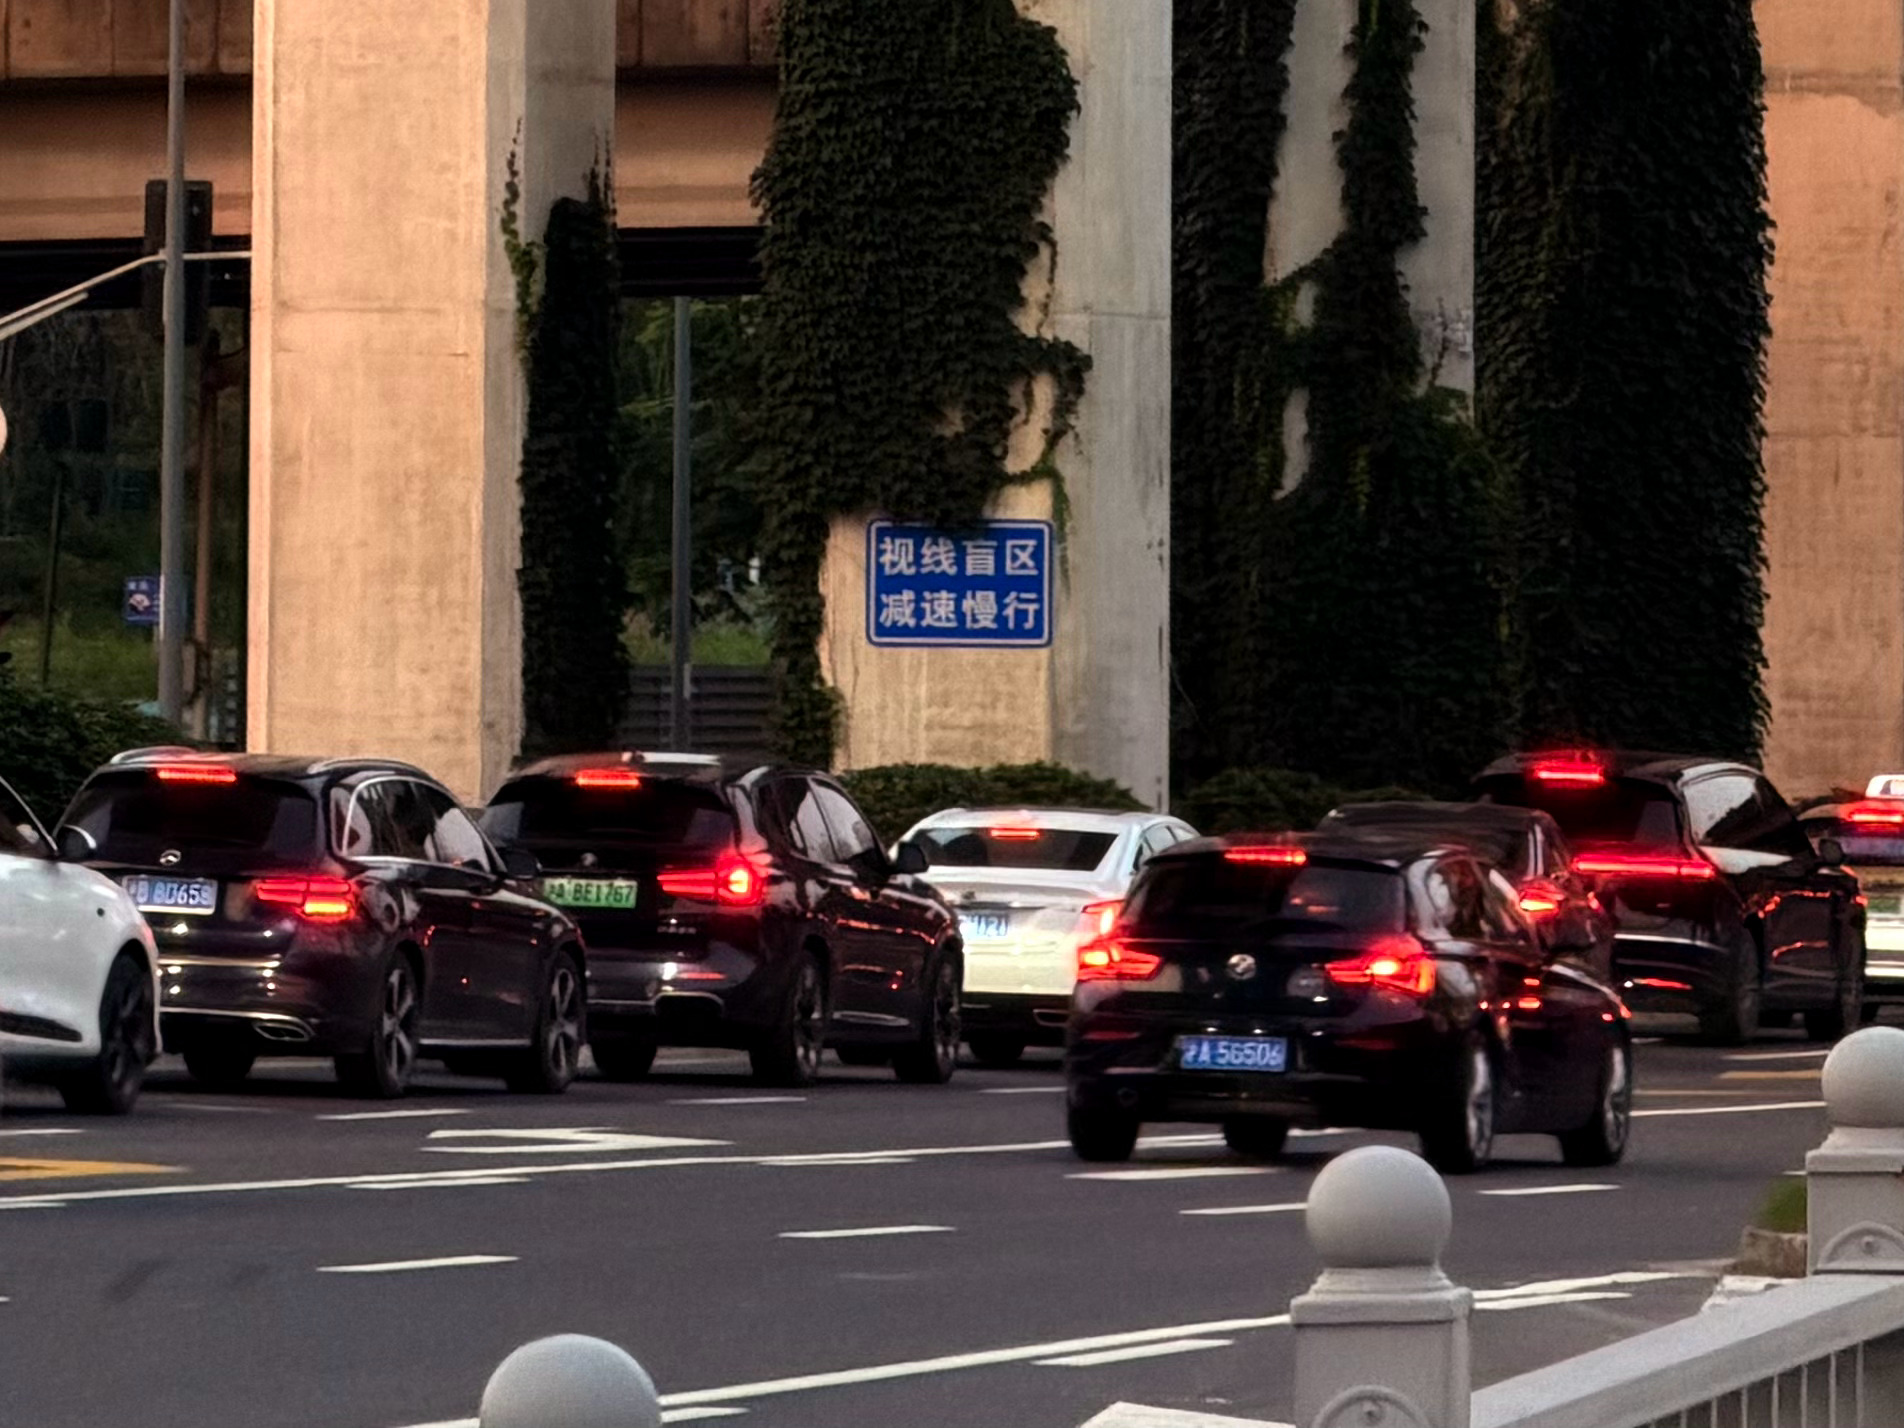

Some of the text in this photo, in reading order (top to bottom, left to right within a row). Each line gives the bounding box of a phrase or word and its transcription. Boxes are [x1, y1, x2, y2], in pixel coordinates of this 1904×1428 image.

[879, 536, 1039, 576] 视线盲区
[879, 589, 1040, 630] 减速慢行
